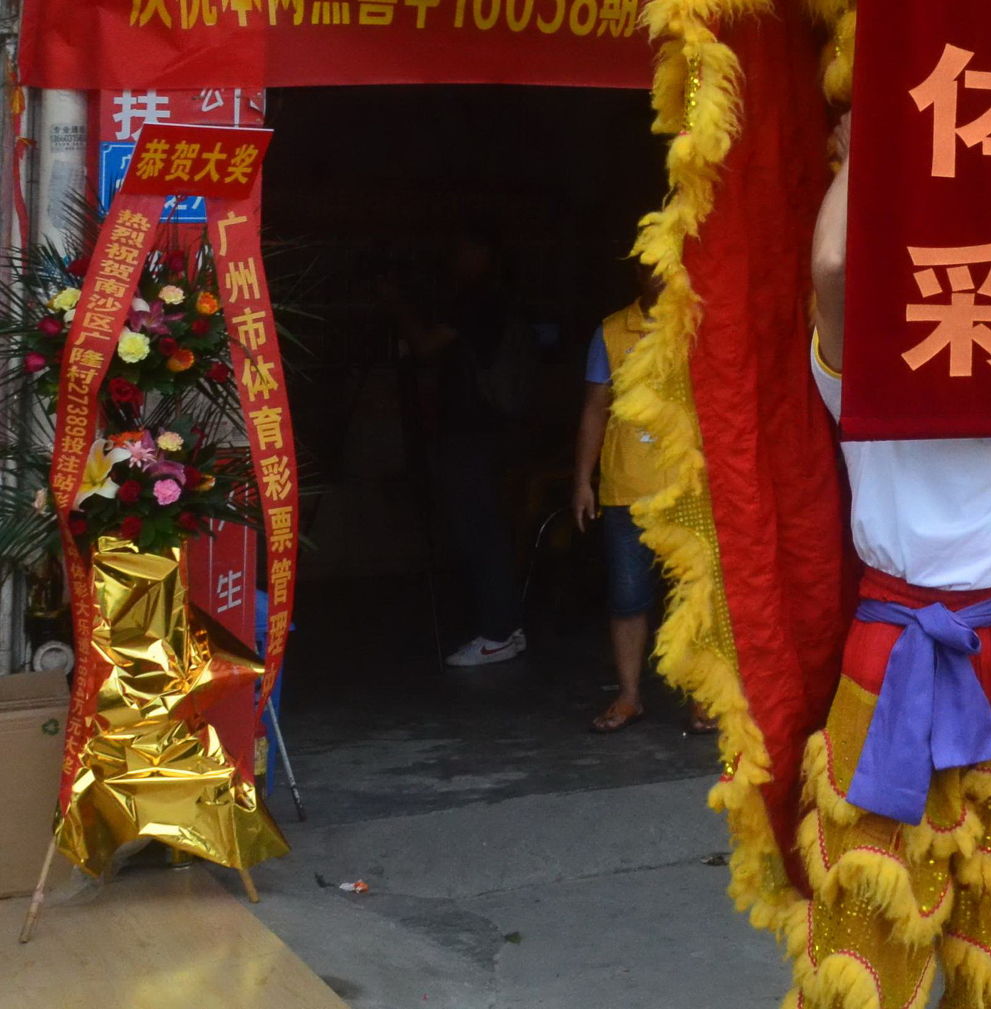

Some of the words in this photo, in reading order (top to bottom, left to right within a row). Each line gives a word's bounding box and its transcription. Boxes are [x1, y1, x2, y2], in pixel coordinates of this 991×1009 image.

[136, 139, 259, 185] 恭贺大奖
[216, 570, 243, 614] 生
